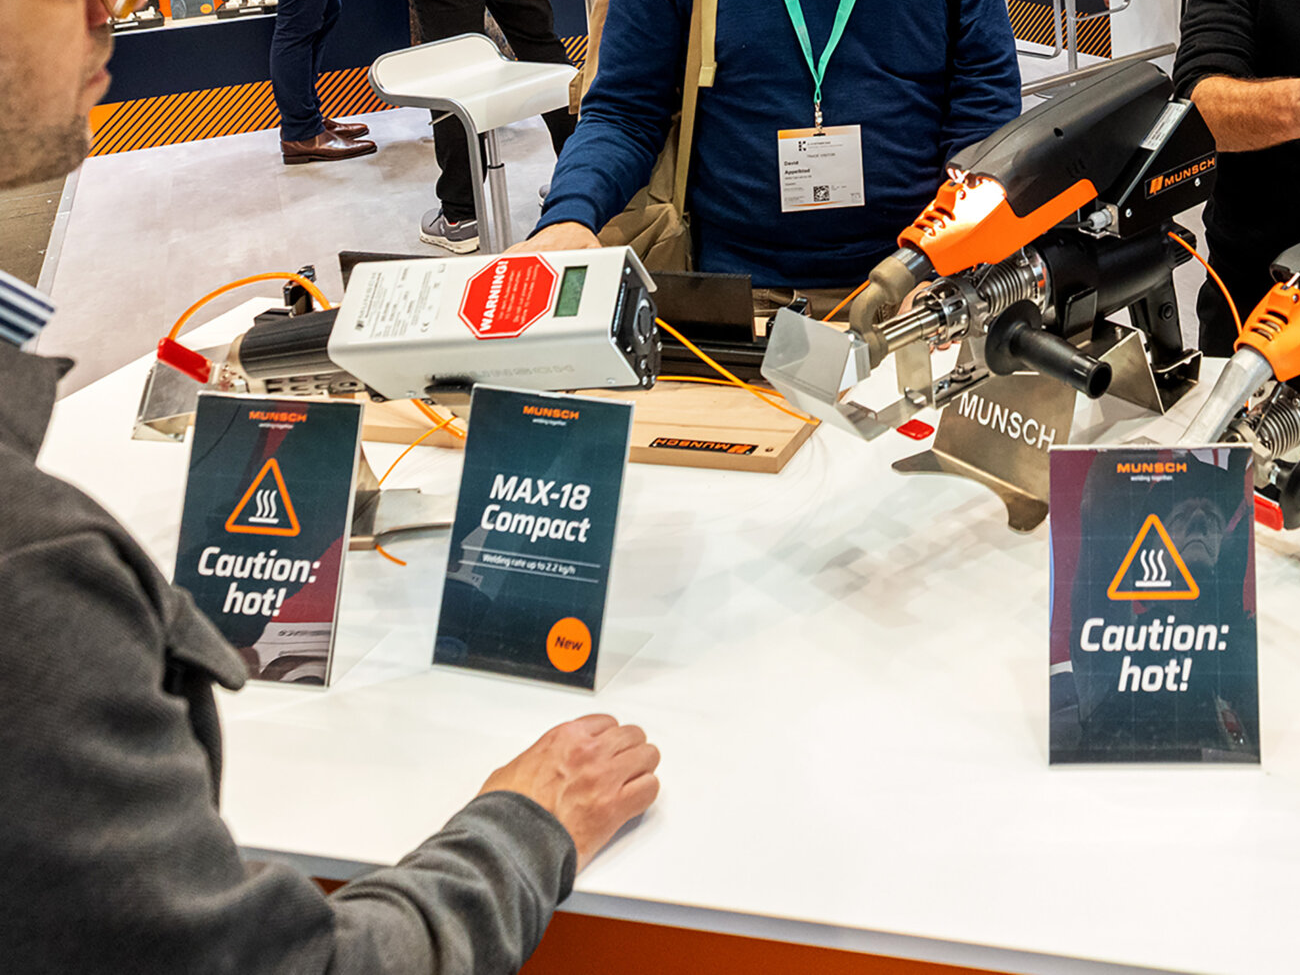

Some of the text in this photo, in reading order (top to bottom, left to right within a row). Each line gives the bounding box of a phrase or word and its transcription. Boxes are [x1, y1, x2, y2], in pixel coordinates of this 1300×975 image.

[1163, 157, 1216, 188] MUNSCH
[480, 260, 509, 331] WARNING!
[248, 410, 308, 423] MUNSCH
[523, 405, 580, 420] MUNSCH
[958, 392, 1057, 453] MUNSCH
[1116, 462, 1188, 474] MUNSCH
[489, 474, 591, 511] MAX-18
[480, 504, 591, 543] Compact
[198, 545, 322, 584] Caution:
[482, 553, 510, 568] Welding
[222, 582, 287, 617] hot!
[554, 635, 583, 652] New
[1080, 615, 1230, 652] Caution:
[1117, 656, 1193, 692] hot!
